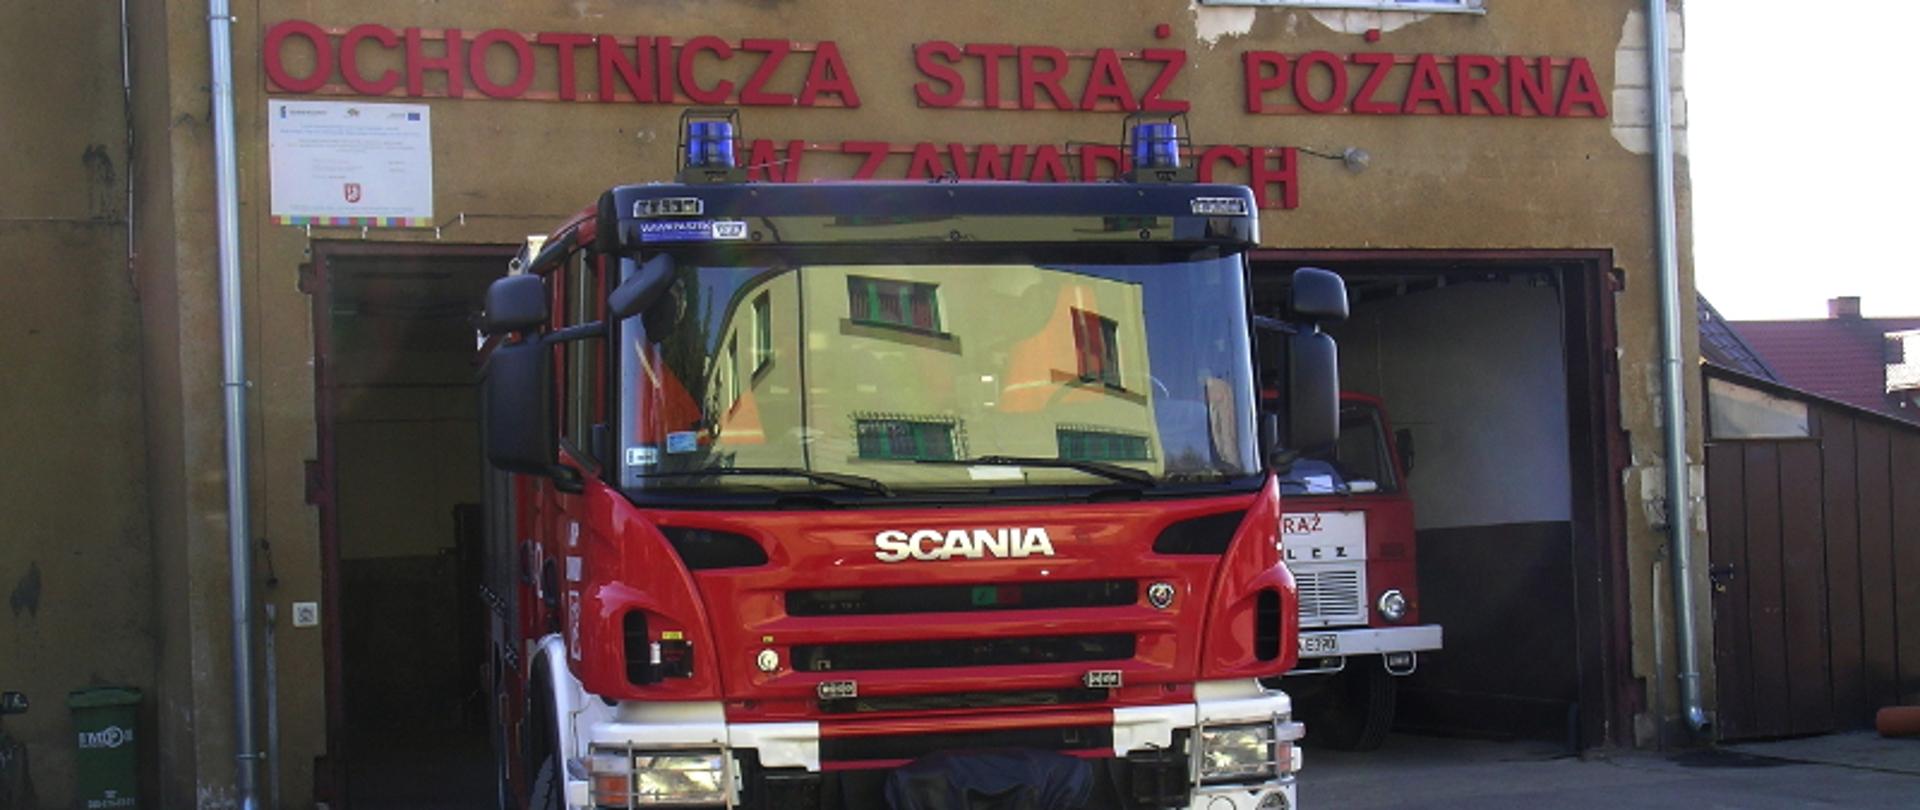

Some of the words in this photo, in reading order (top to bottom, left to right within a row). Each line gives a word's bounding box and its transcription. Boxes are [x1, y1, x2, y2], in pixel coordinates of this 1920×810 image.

[263, 20, 861, 108] OCHOTNICZA
[914, 24, 1191, 112] STRAŻ
[1243, 28, 1609, 118] POŻARNA
[733, 139, 804, 183] W
[841, 141, 1299, 209] ZAWADCH
[874, 527, 1055, 561] SCANIA
